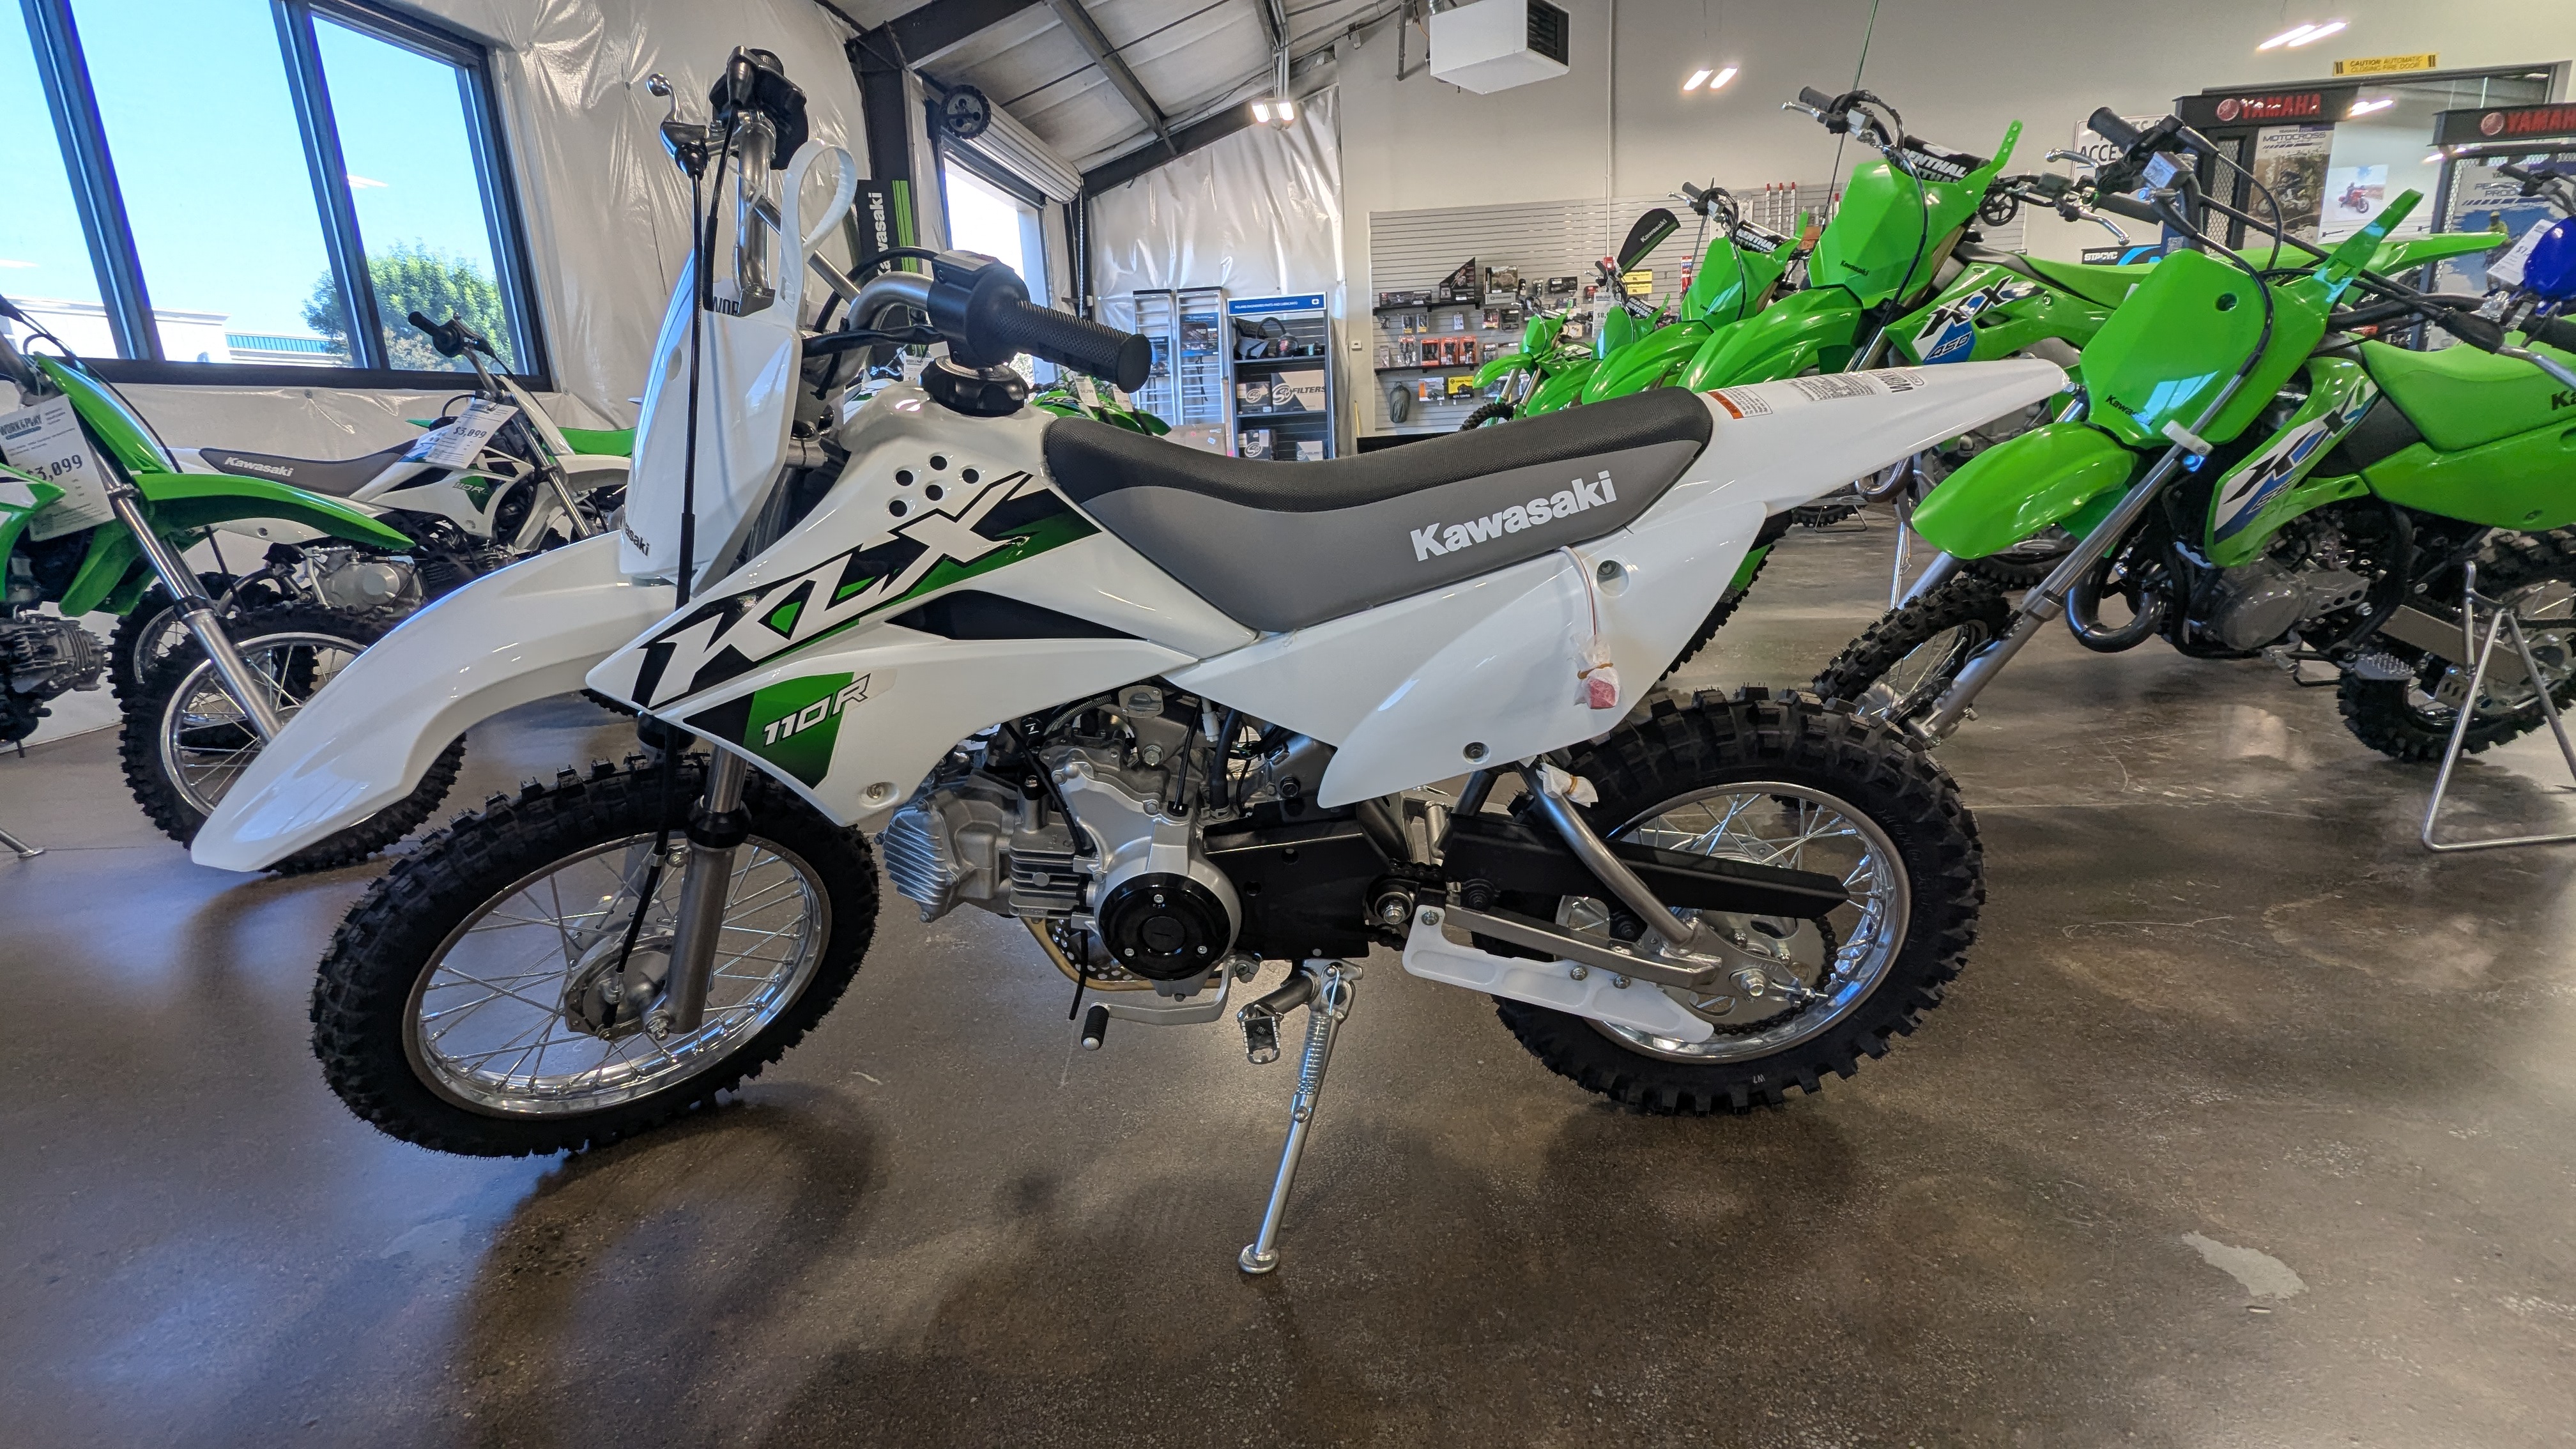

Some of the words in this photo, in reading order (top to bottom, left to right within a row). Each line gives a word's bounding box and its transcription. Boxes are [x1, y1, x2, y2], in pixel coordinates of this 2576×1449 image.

[2241, 93, 2322, 120] YAMAHA
[2506, 108, 2576, 134] YAMAH
[2262, 131, 2327, 142] MOTOCROSS
[2080, 144, 2117, 162] ACCE
[1640, 218, 1667, 243] Kawasaki
[1736, 228, 1777, 252] RENTHAL
[1839, 259, 1870, 277] Kawasaki
[1926, 331, 1973, 360] 450
[1292, 385, 1326, 395] FILTERS
[453, 426, 487, 438] $3,099
[224, 456, 295, 477] Kawasaki
[1410, 470, 1617, 562] Kawasaki
[625, 523, 650, 557] asaki
[762, 673, 871, 747] 110R
